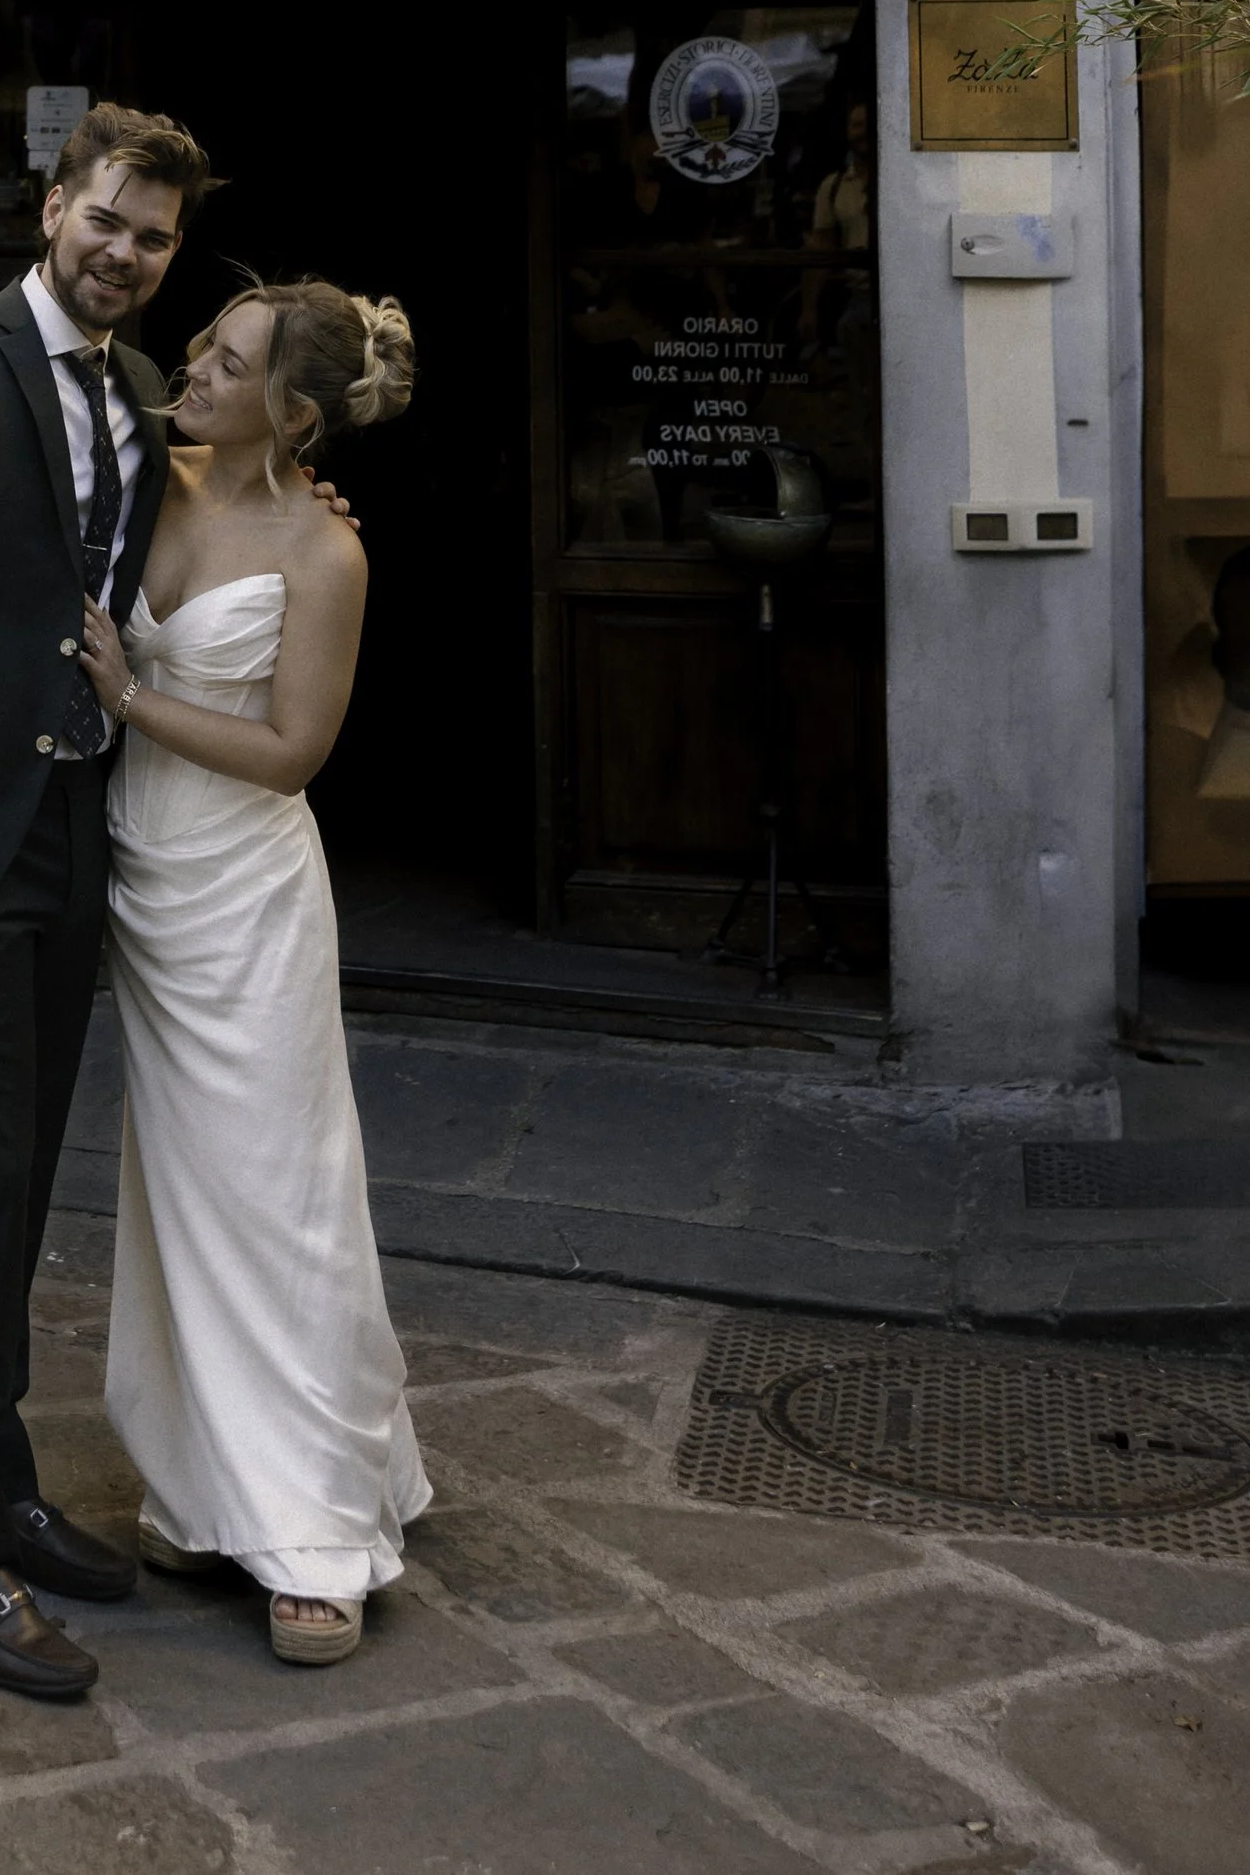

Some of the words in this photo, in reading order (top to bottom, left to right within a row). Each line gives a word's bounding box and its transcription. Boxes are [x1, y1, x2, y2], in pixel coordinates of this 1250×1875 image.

[657, 63, 681, 126] ESERCIZI
[677, 40, 736, 65] STORICI
[966, 85, 1019, 93] FIRENZE
